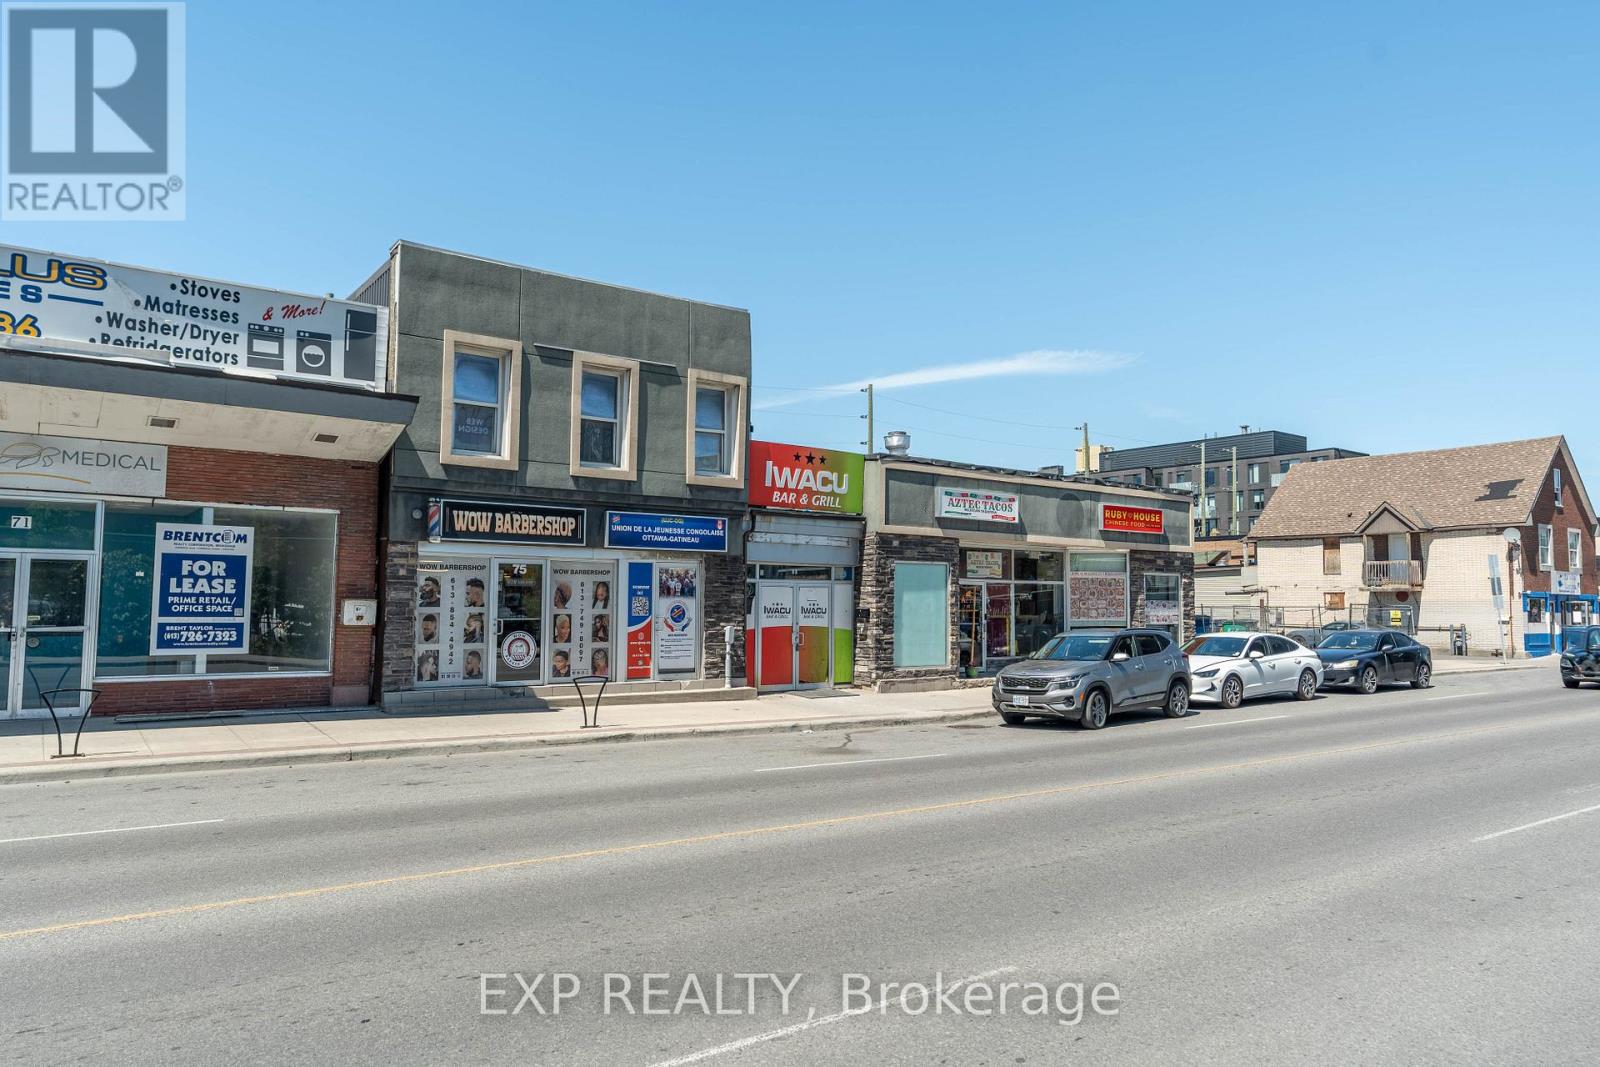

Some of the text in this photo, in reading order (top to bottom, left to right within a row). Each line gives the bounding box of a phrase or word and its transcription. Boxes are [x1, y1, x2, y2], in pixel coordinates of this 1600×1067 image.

[0, 253, 107, 290] US
[180, 279, 241, 303] Stoves
[144, 295, 240, 324] Matresses
[262, 300, 327, 321] & More!
[106, 311, 240, 346] Washer/Dryer
[62, 450, 161, 472] MEDICAL
[765, 460, 849, 494] IWACU
[772, 491, 842, 508] BAR & GRILL
[947, 497, 1013, 512] AZTEC TACOS
[12, 516, 29, 528] 71
[452, 510, 576, 537] WOW BARBERSHOP
[1105, 509, 1160, 523] RUBY HOUSE
[163, 529, 248, 544] BRENTCOM
[611, 524, 632, 532] UNION
[686, 528, 724, 537] CONGOLAISE
[642, 534, 699, 543] OTTAWA-GATINEAU
[181, 559, 227, 576] FOR
[512, 564, 527, 575] 75
[169, 577, 237, 594] LEASE
[168, 596, 237, 605] PRIME RETAIL/
